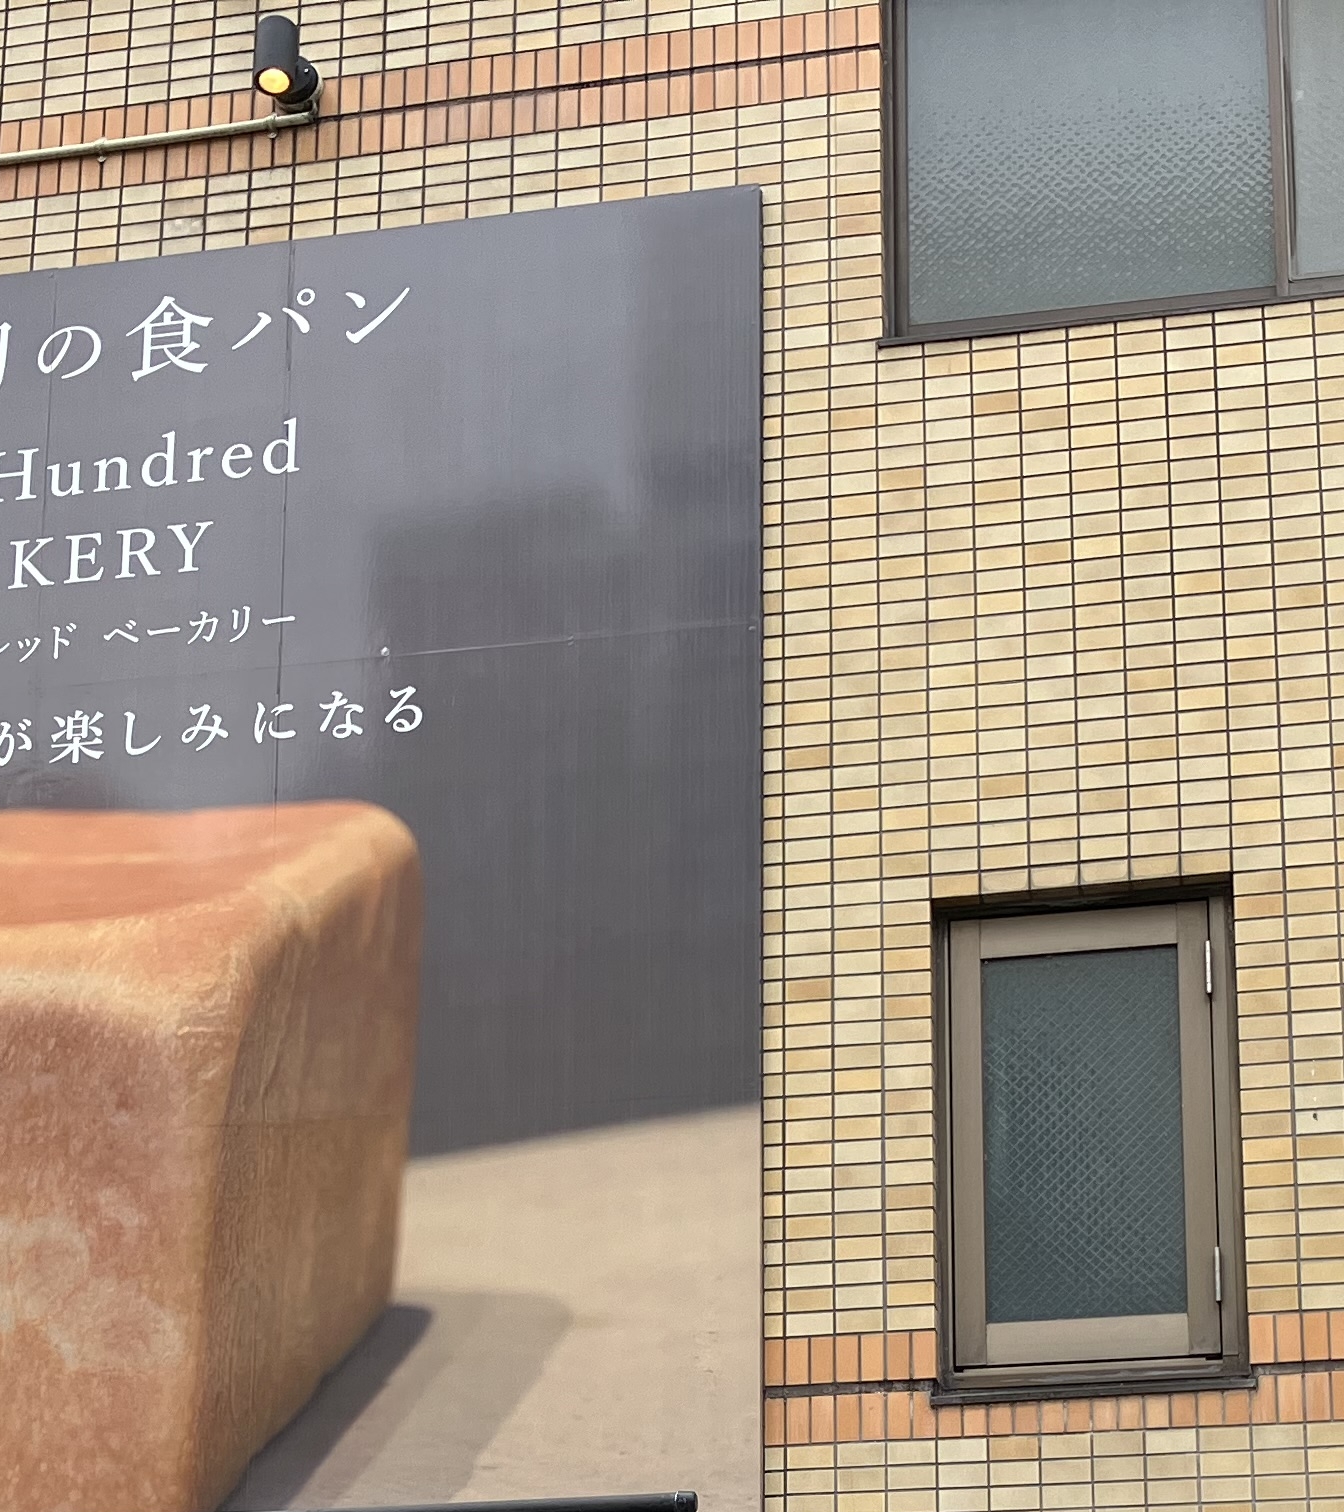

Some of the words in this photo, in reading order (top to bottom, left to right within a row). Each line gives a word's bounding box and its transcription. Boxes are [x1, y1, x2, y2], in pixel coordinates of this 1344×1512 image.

[102, 607, 297, 648] ベーカリー
